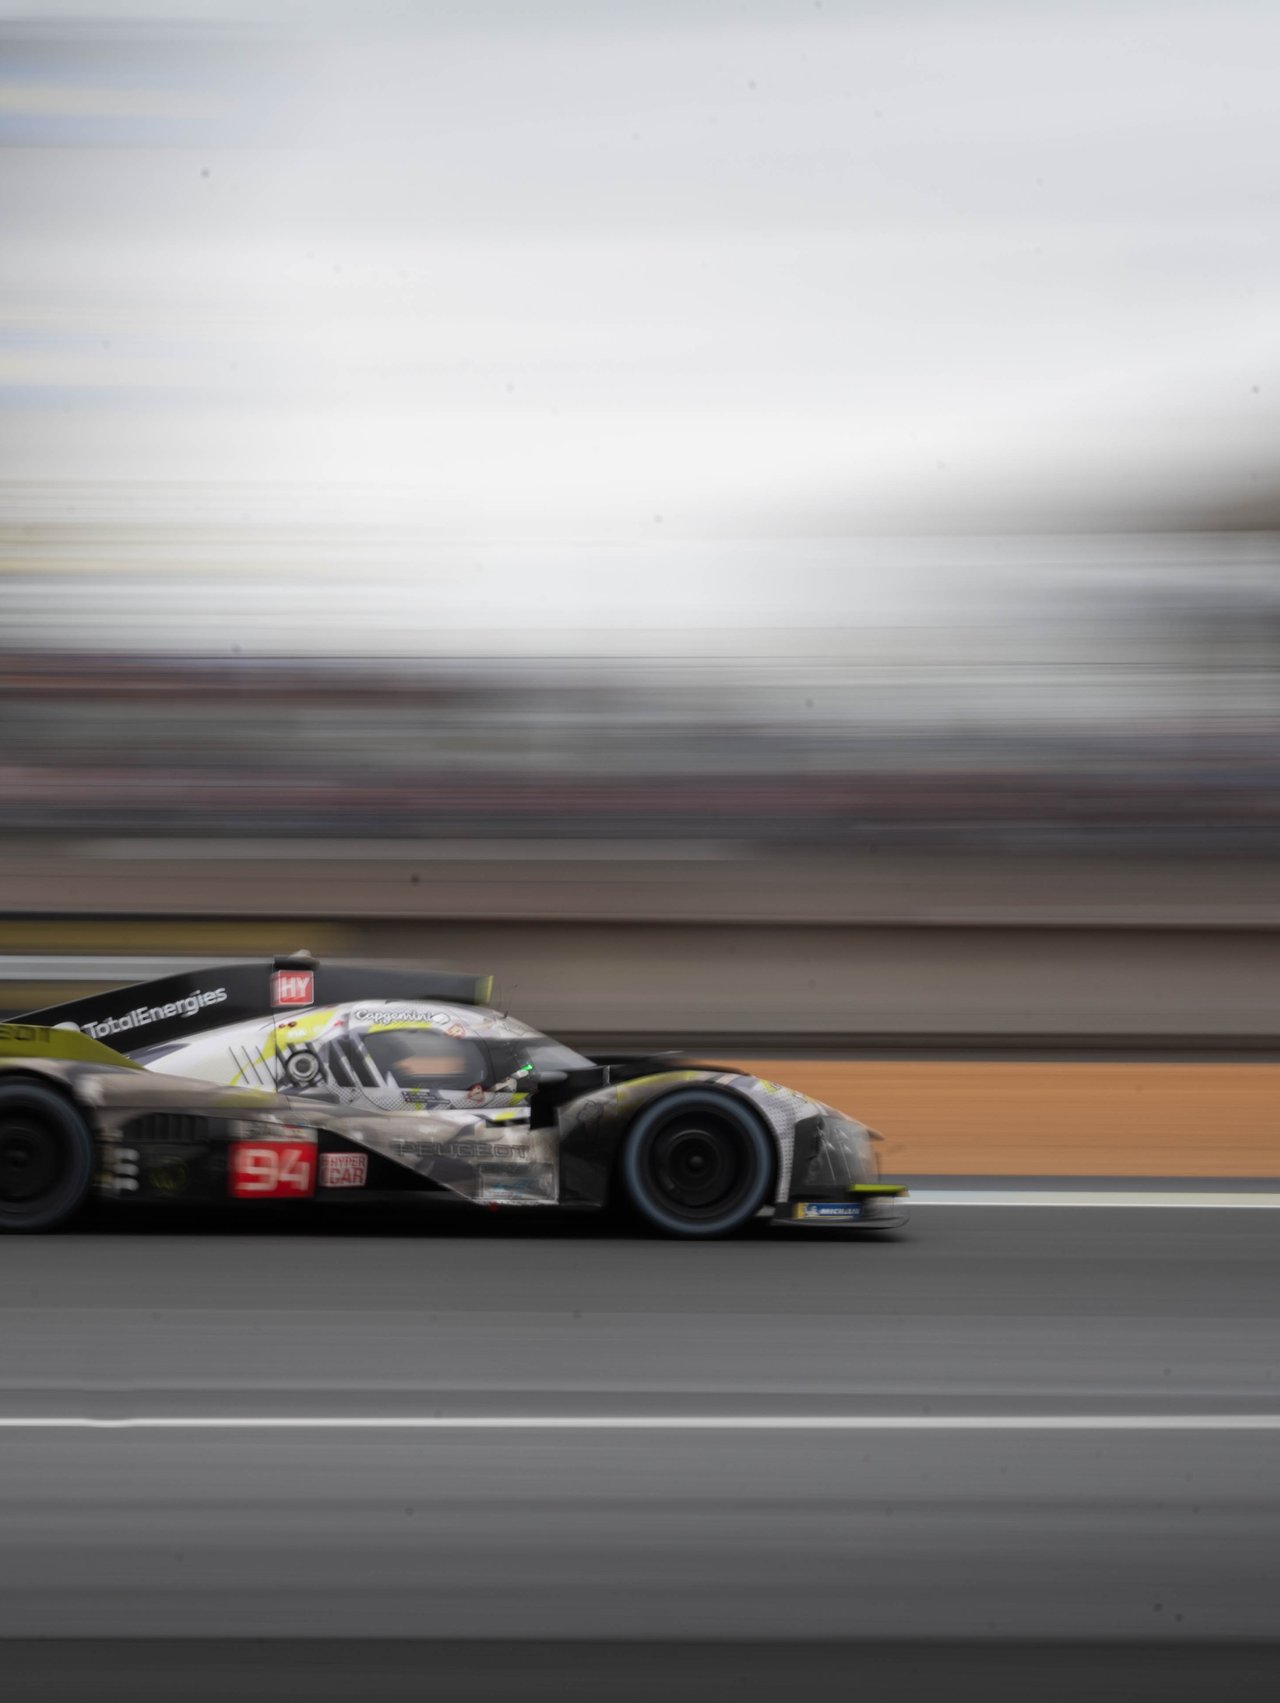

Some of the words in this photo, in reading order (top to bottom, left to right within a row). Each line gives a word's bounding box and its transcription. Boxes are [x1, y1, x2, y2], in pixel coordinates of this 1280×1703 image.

[280, 976, 311, 998] HY
[81, 987, 228, 1040] TotalEnergies
[354, 1009, 434, 1025] Capgemini
[398, 1140, 531, 1159] PEUGEOT
[235, 1147, 311, 1192] 94
[329, 1155, 366, 1169] HYPER
[328, 1167, 365, 1185] CAR
